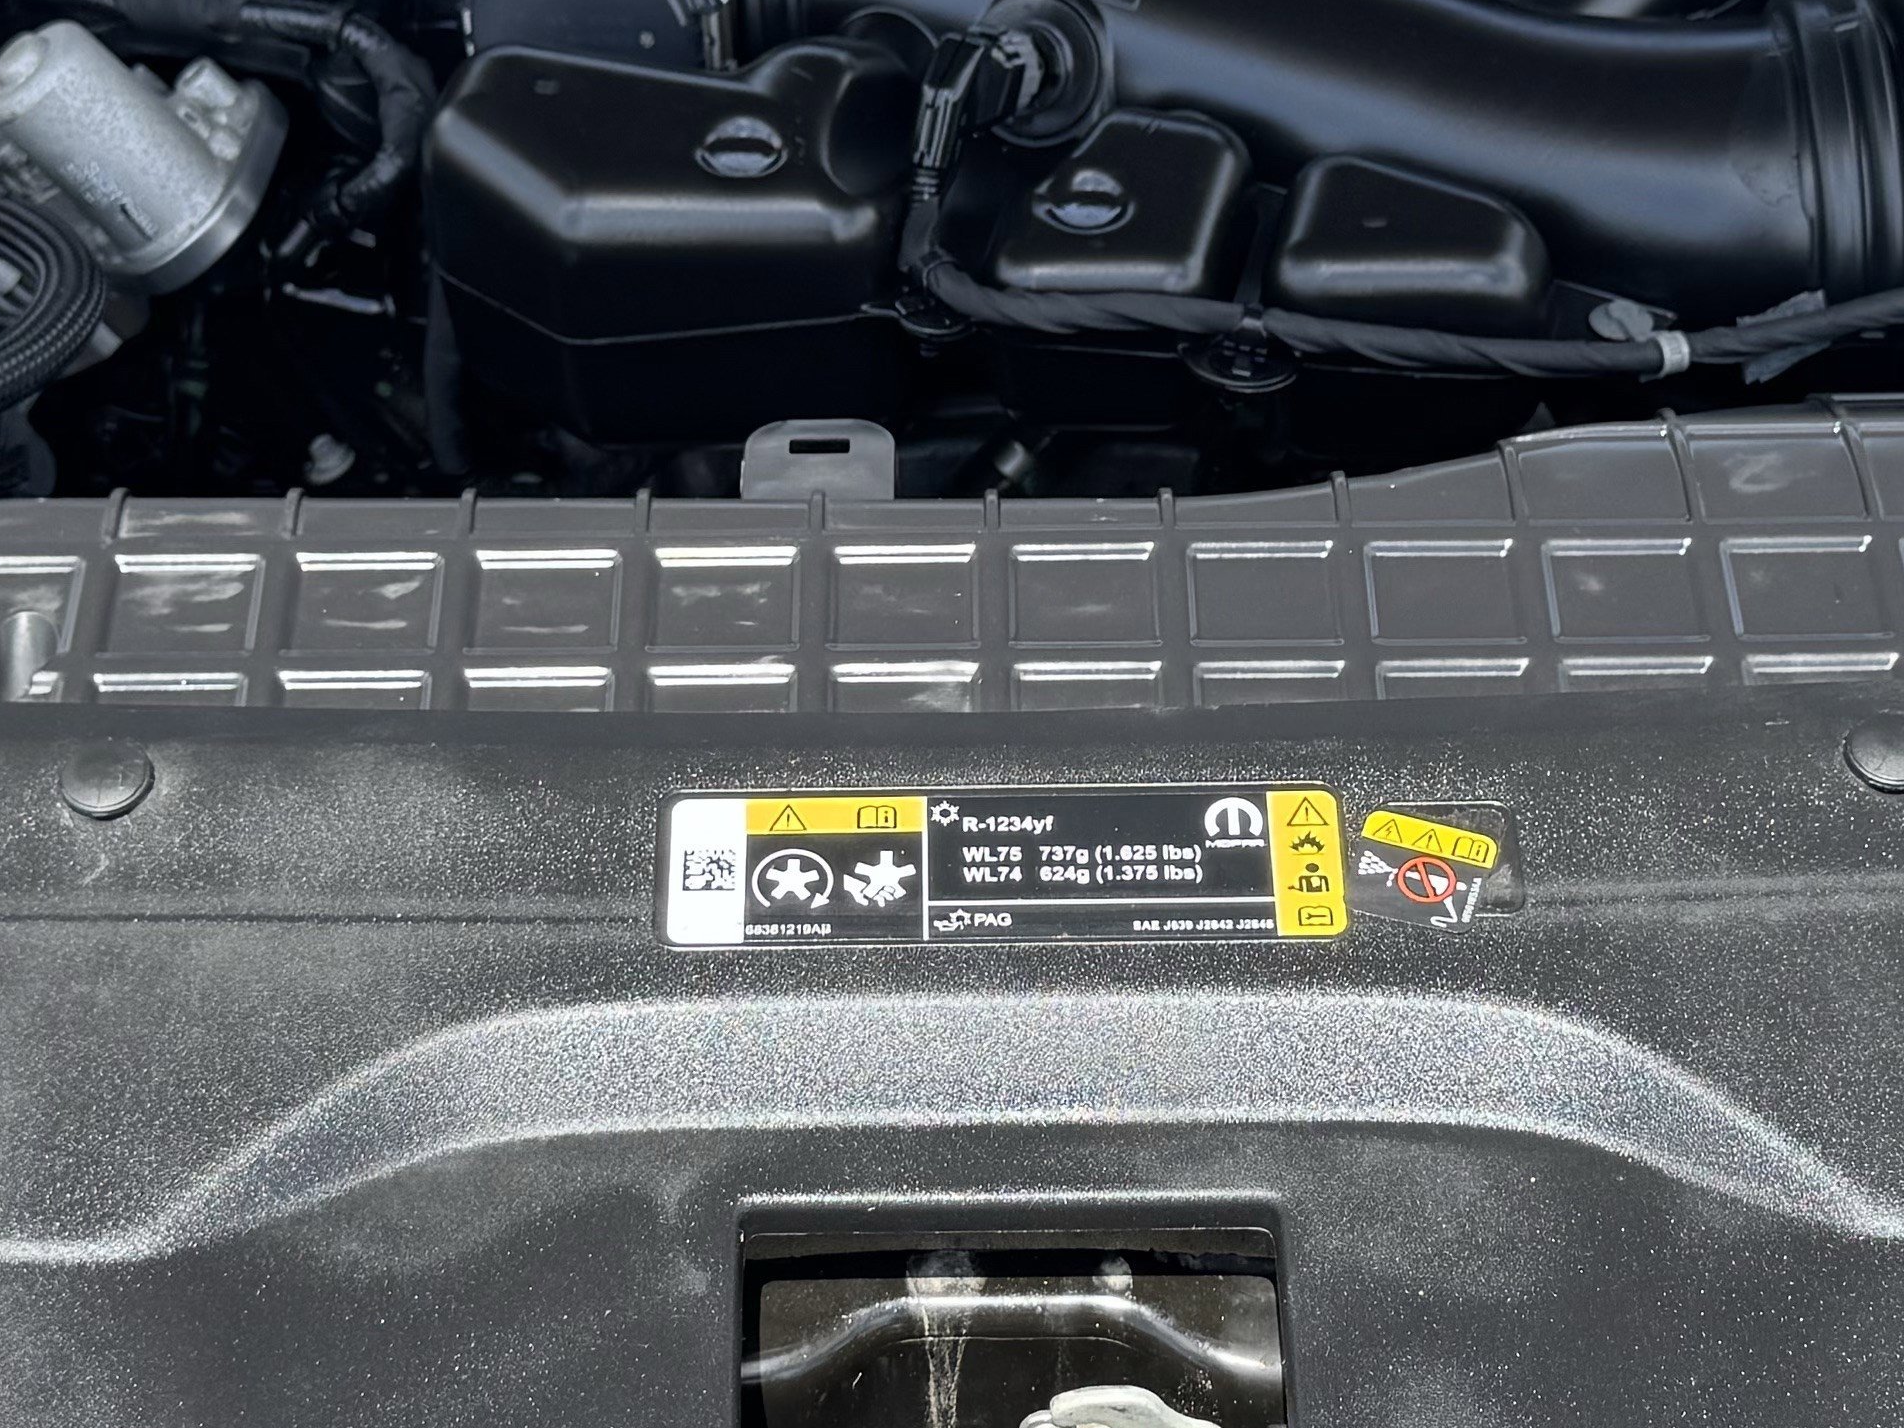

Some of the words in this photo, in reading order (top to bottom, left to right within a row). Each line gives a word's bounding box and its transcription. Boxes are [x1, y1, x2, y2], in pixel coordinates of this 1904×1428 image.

[962, 814, 1054, 835] R-1234yf
[962, 845, 1023, 863] WL75
[1038, 845, 1089, 865] 737g
[1094, 844, 1158, 865] (1.625
[1162, 843, 1202, 864] lbs)
[962, 865, 1023, 883] WL74
[1039, 865, 1091, 885] 624g
[1095, 864, 1159, 885] (1.375
[1163, 863, 1204, 884] lbs)
[973, 912, 1013, 927] PAG
